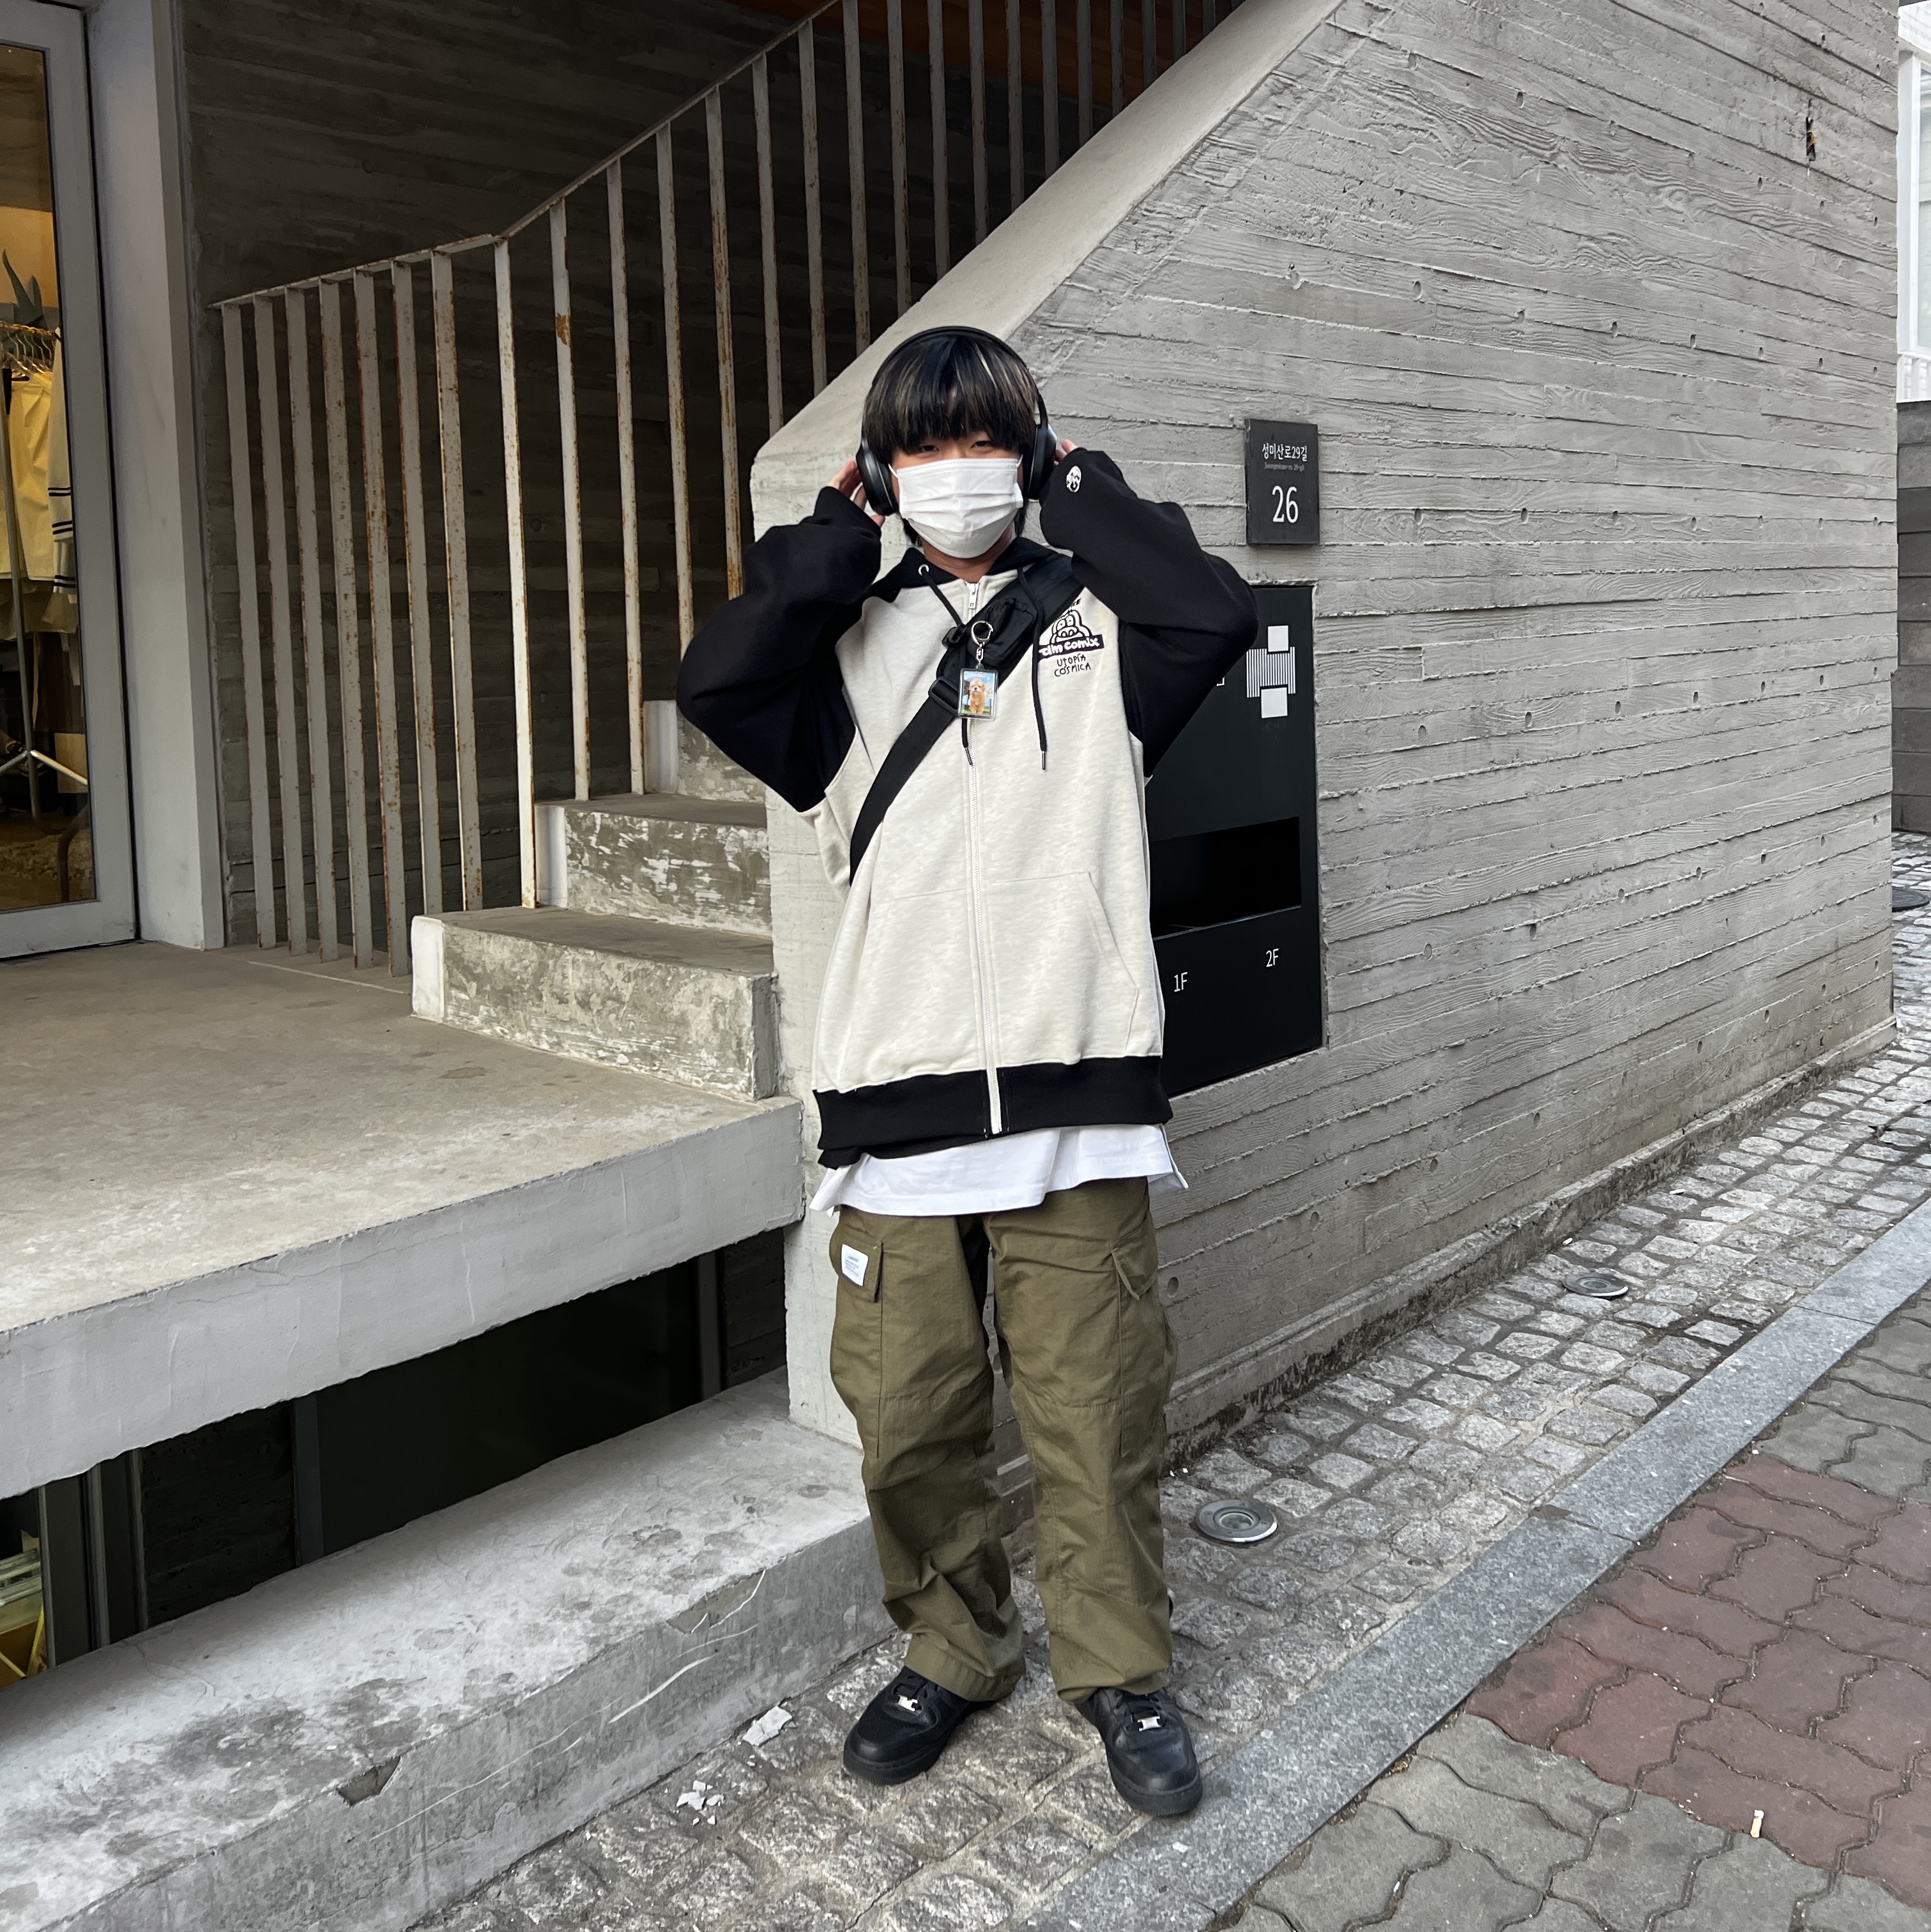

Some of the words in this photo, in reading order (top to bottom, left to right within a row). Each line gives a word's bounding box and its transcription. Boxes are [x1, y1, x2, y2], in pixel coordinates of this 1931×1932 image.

[1262, 442, 1308, 462] 성미산로29길
[1272, 485, 1299, 523] 26
[1265, 948, 1279, 968] 2F
[1173, 971, 1188, 993] 1F
